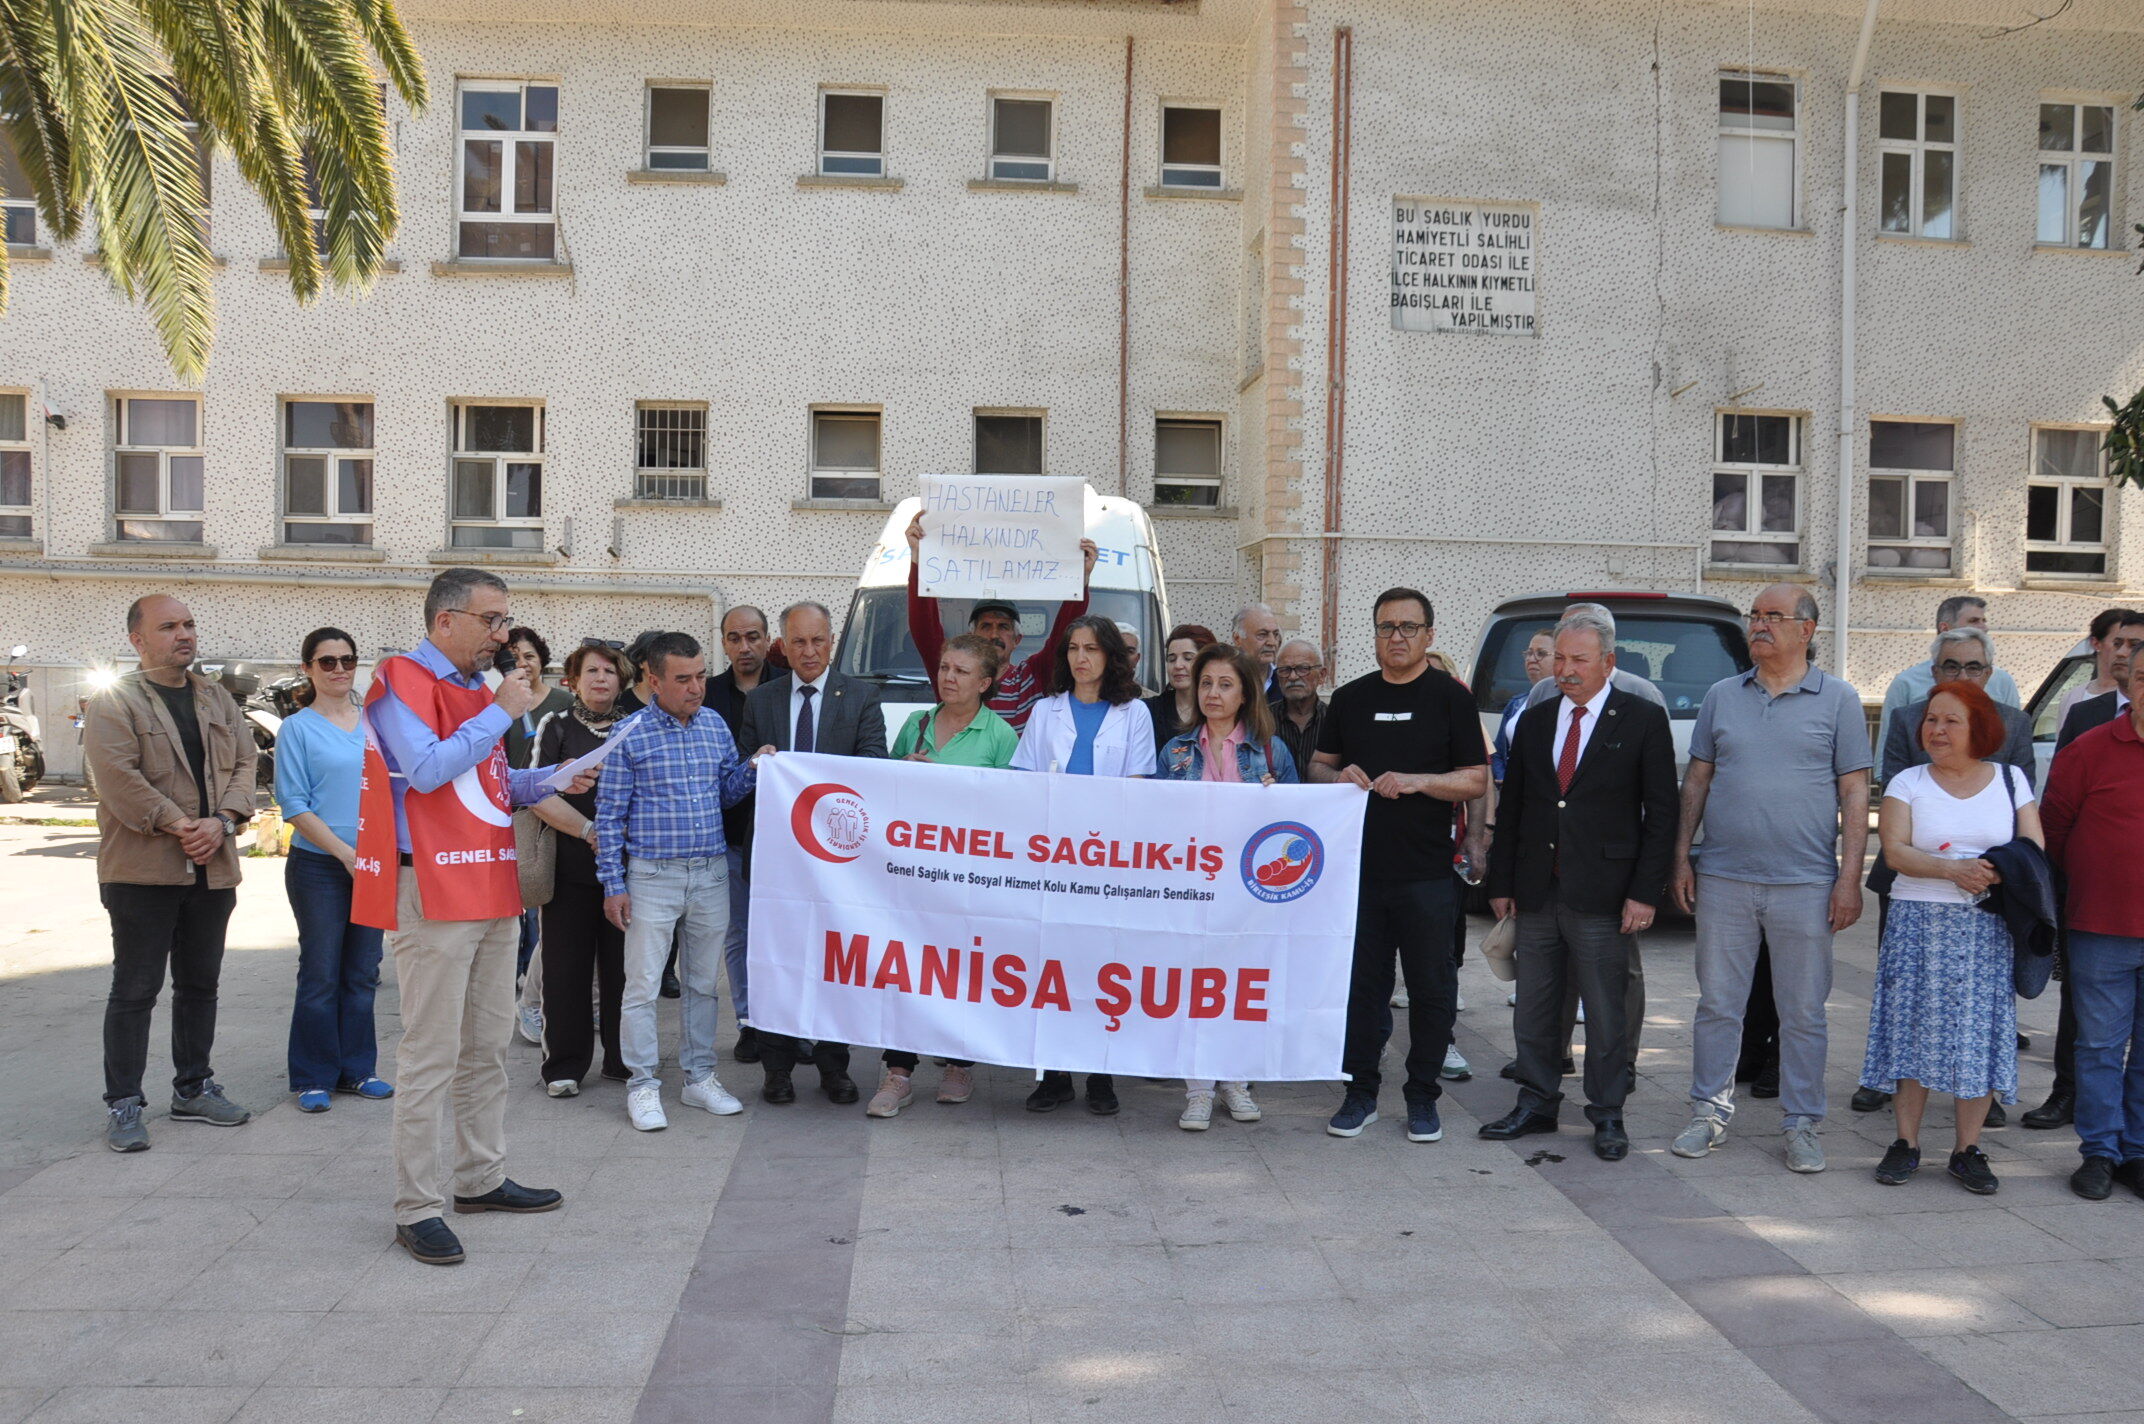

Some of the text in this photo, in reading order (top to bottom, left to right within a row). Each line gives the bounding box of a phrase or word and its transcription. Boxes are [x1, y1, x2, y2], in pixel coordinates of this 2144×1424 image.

[1396, 208, 1415, 223] BU
[1483, 212, 1530, 229] YURDU
[1396, 227, 1530, 250] HAMİYETLİ SALİHLİ
[1397, 247, 1530, 271] TİCARET ODASI İLE
[1391, 268, 1535, 292] İLÇE HALKININ KIYMETLİ
[1470, 292, 1493, 312] İLE
[1451, 312, 1535, 330] YAPILMIŞTIR
[926, 484, 1060, 517] HASTANELER
[940, 524, 1043, 550] HALKINDIR
[435, 849, 496, 865] GENEL
[886, 820, 1014, 859] GENEL
[1028, 830, 1225, 881] SAĞLIK-İŞ
[886, 862, 1215, 901] Genel Sağlık ve Sosyal Hizmet Kolu Kamu Çalışanları Sendikası
[823, 930, 1271, 1032] MANİSA ŞUBE
